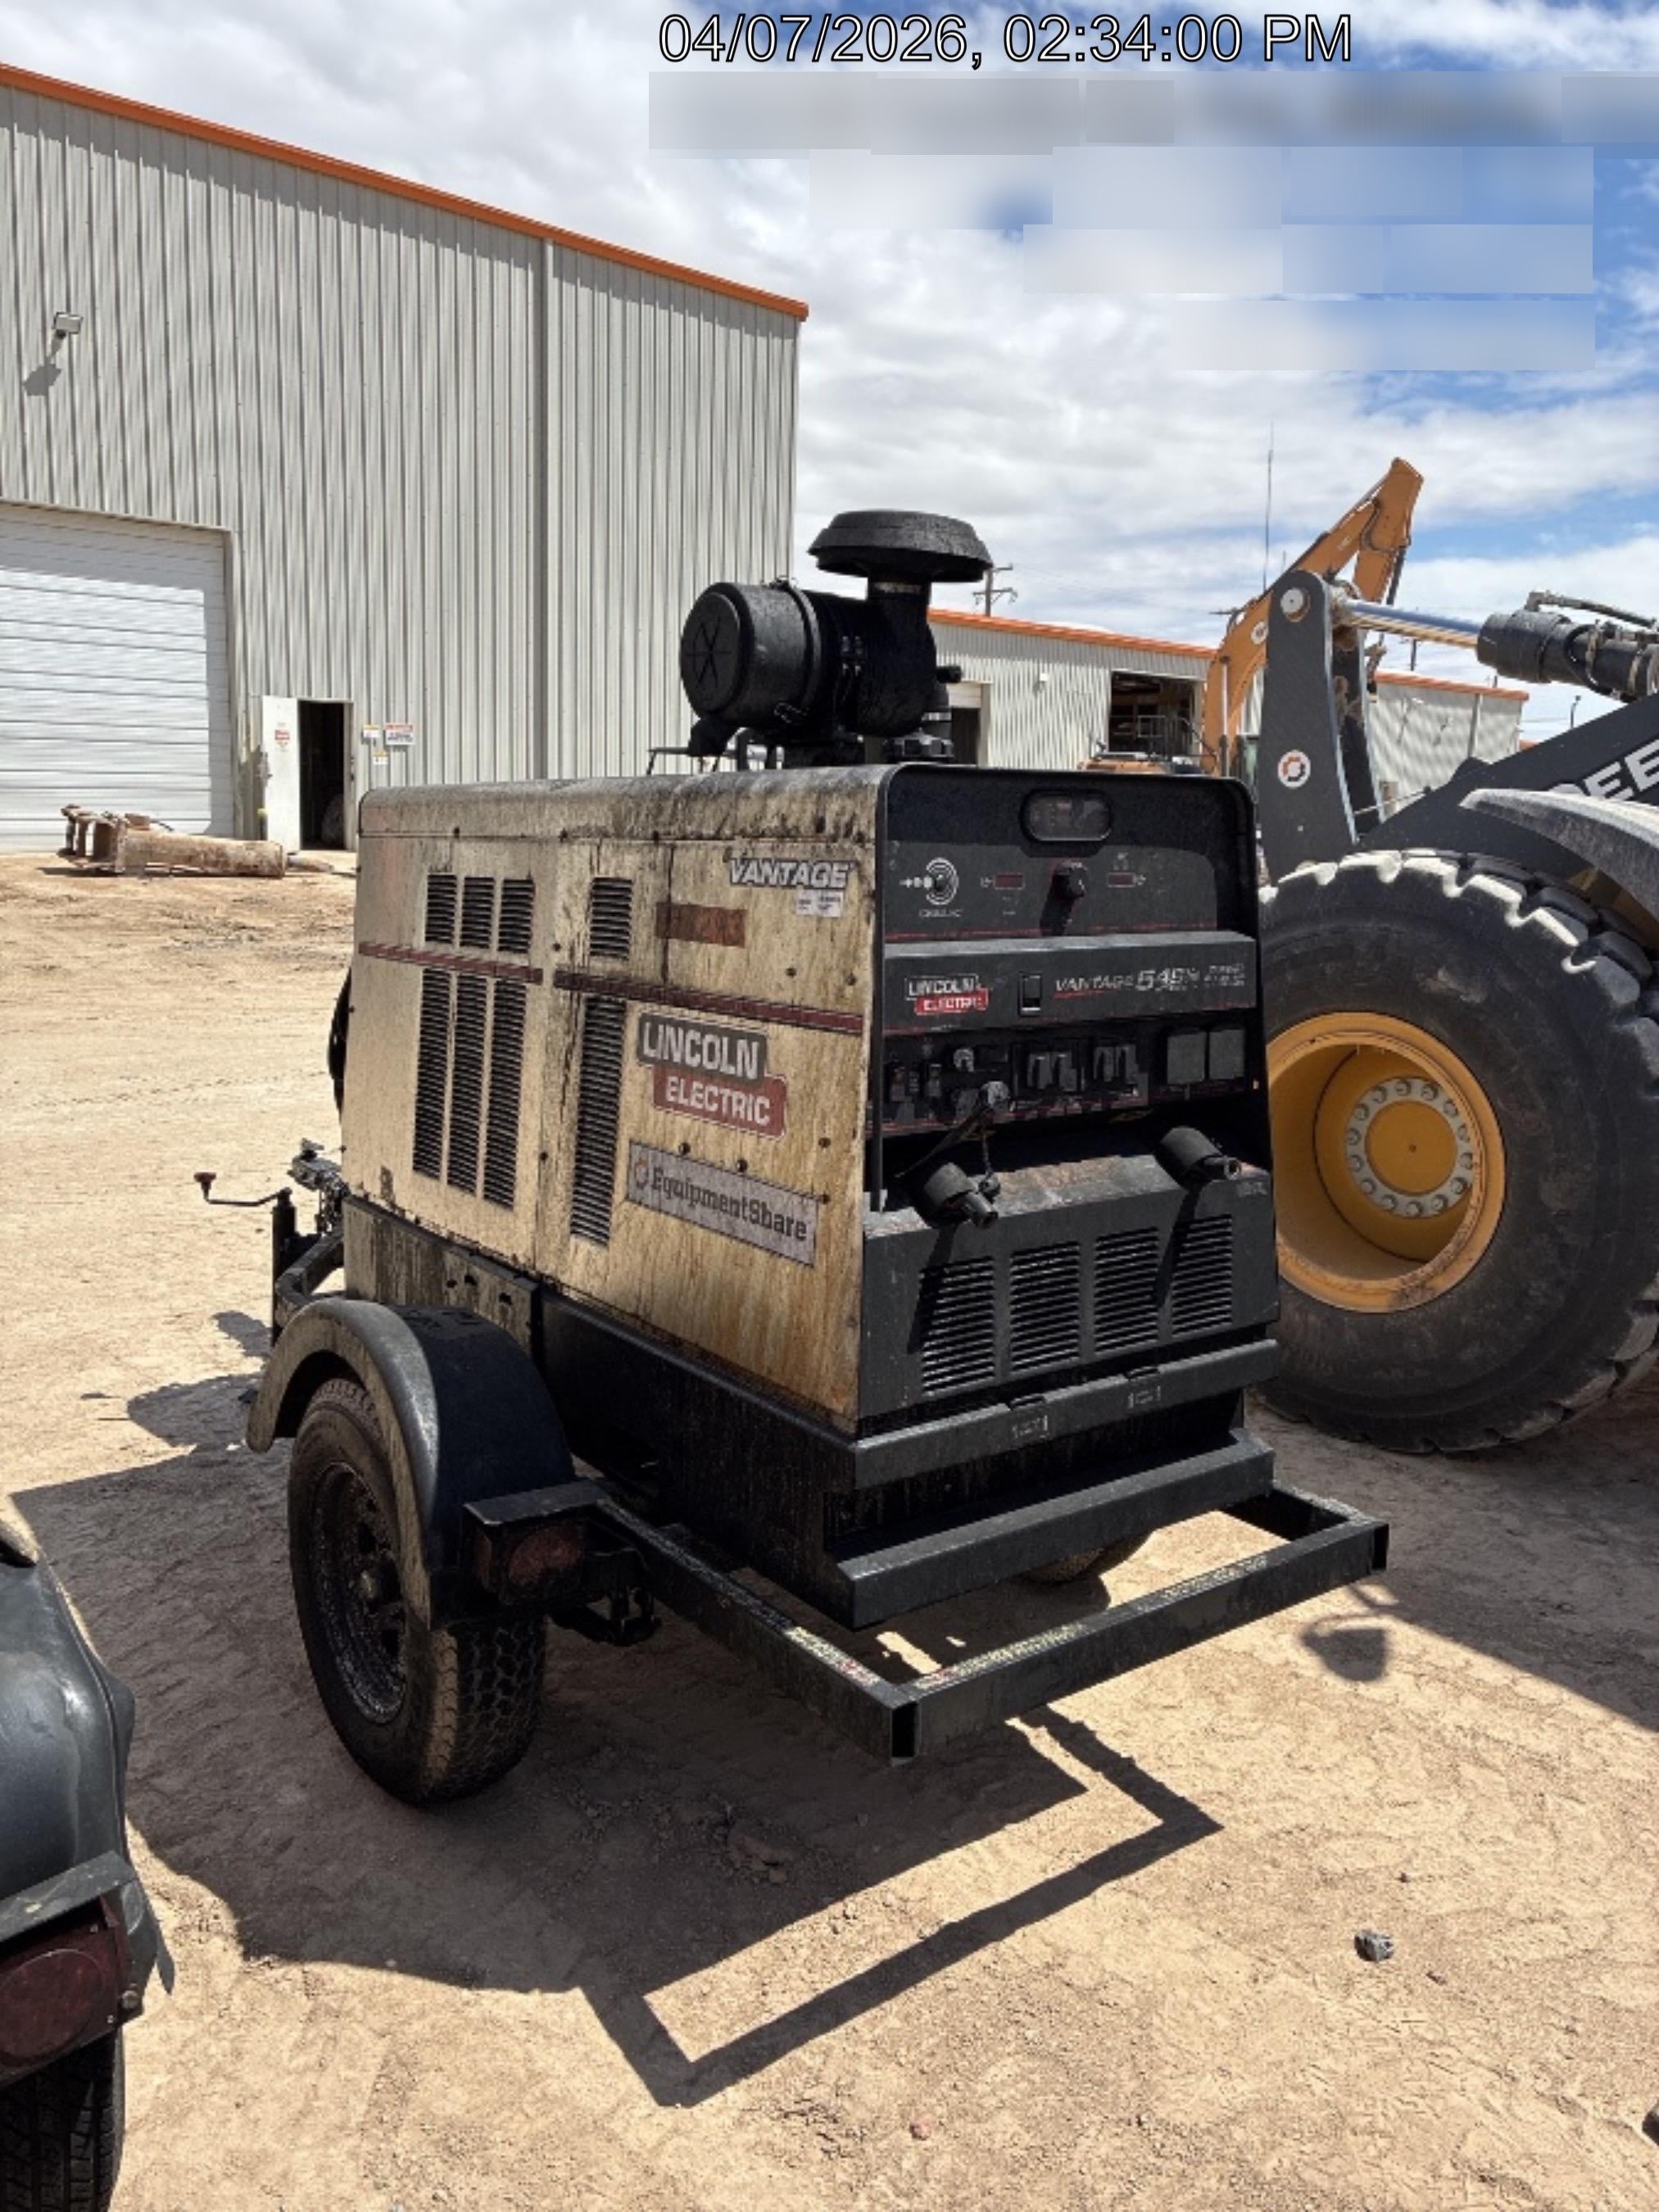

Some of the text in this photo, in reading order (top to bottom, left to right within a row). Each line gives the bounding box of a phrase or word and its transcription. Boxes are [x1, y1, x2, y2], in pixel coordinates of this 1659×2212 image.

[729, 859, 850, 888] VANTAGE
[908, 977, 975, 997] LINCOLN
[642, 1022, 759, 1081] LINCOLN
[666, 1076, 771, 1126] ELECTRIC
[653, 1167, 808, 1242] EquipmentShare
